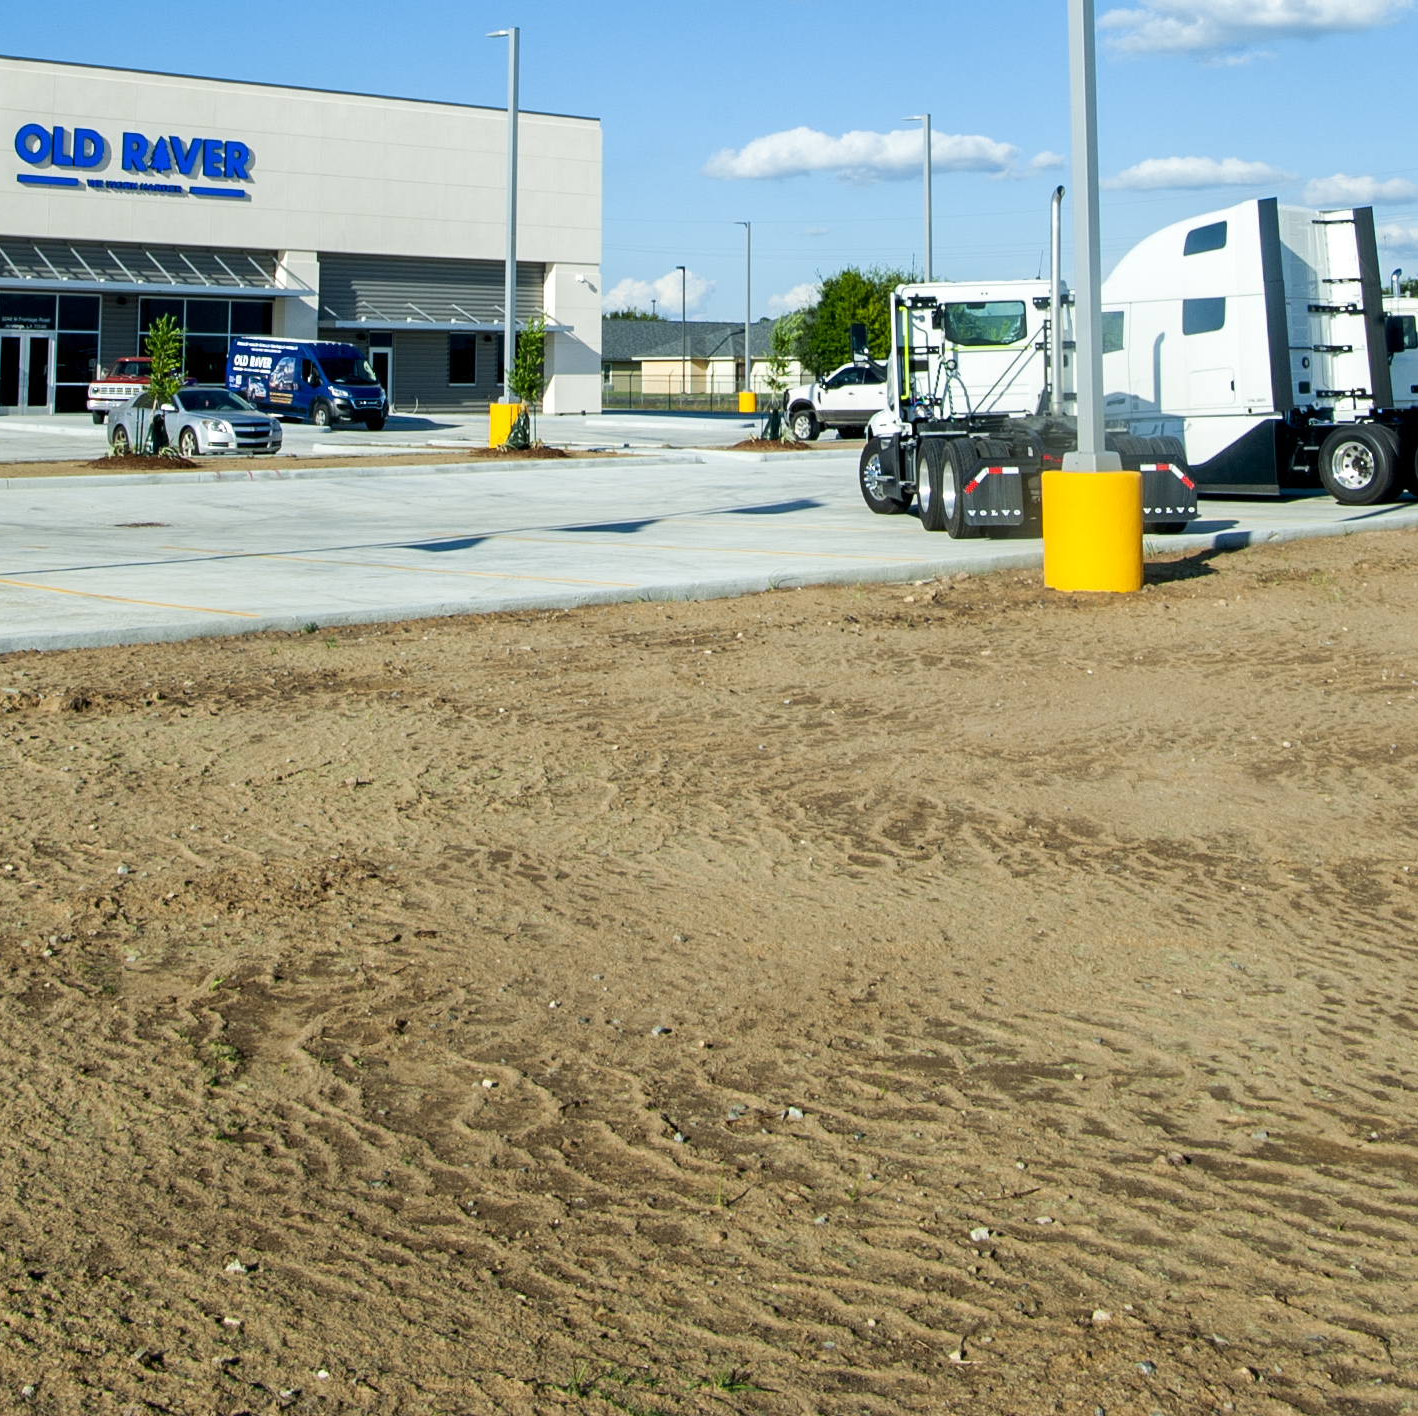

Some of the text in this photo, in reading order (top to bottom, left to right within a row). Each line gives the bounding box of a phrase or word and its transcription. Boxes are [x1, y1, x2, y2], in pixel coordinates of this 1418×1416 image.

[14, 123, 105, 168] OLD
[86, 178, 104, 188] WE
[233, 354, 249, 367] OLD
[967, 509, 1021, 517] VOLVO
[1142, 506, 1196, 515] VOLVO
